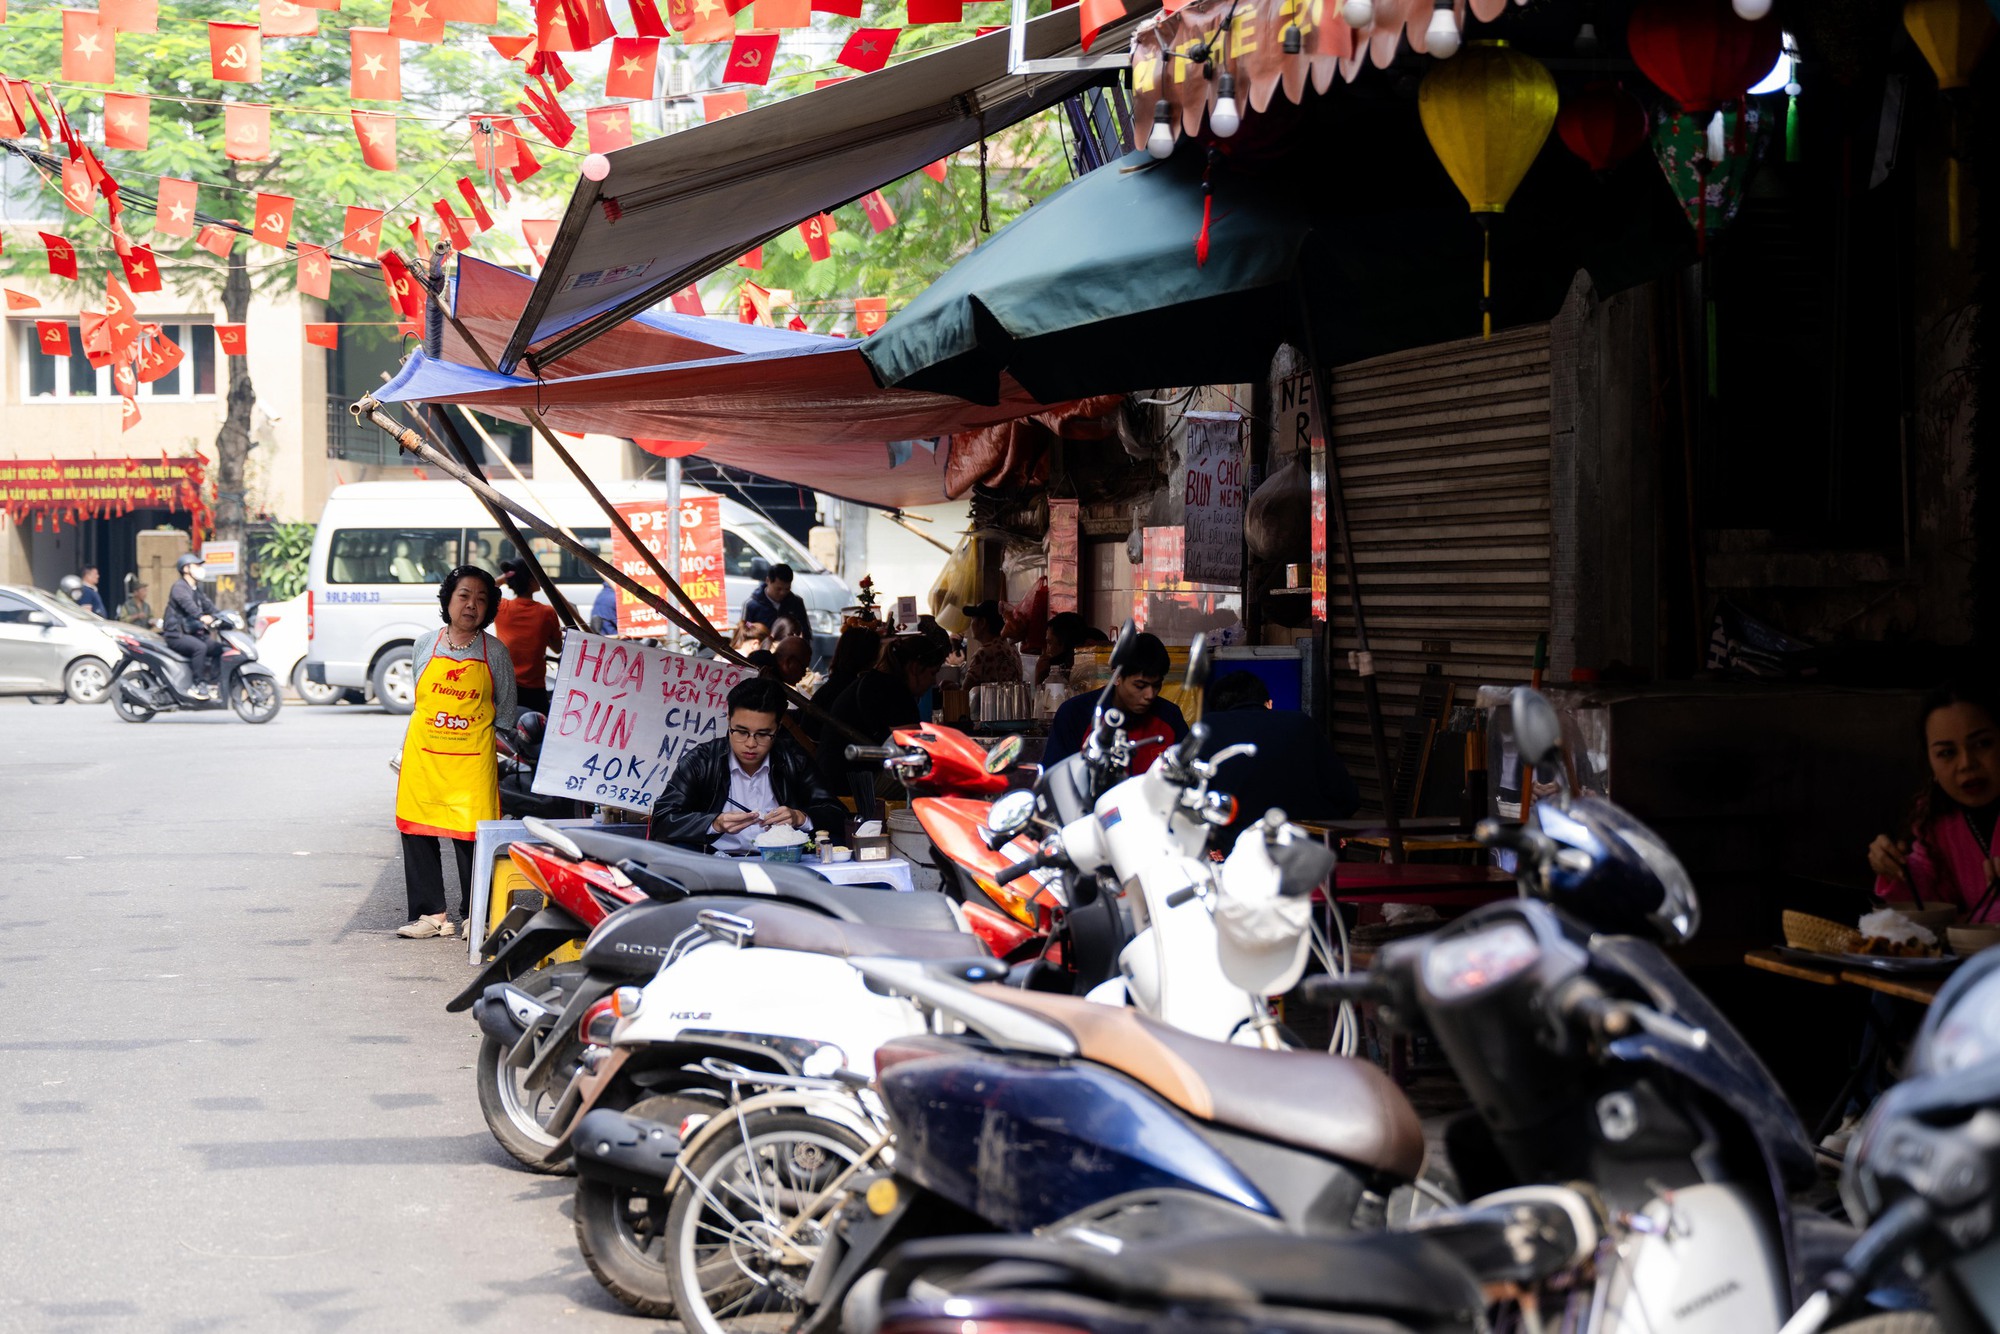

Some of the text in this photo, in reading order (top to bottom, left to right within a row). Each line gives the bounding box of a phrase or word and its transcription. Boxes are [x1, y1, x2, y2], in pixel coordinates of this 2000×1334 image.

[1281, 369, 1312, 413] NE
[1187, 423, 1212, 456] HOA
[1295, 411, 1312, 450] R
[1185, 457, 1212, 508] BÚN
[627, 501, 703, 533] PHỞ
[575, 639, 645, 693] HOA
[659, 655, 688, 678] 17
[558, 688, 638, 750] BÚN
[664, 707, 729, 741] CHẢ
[656, 734, 699, 764] NE
[565, 775, 661, 807] ĐT 03878
